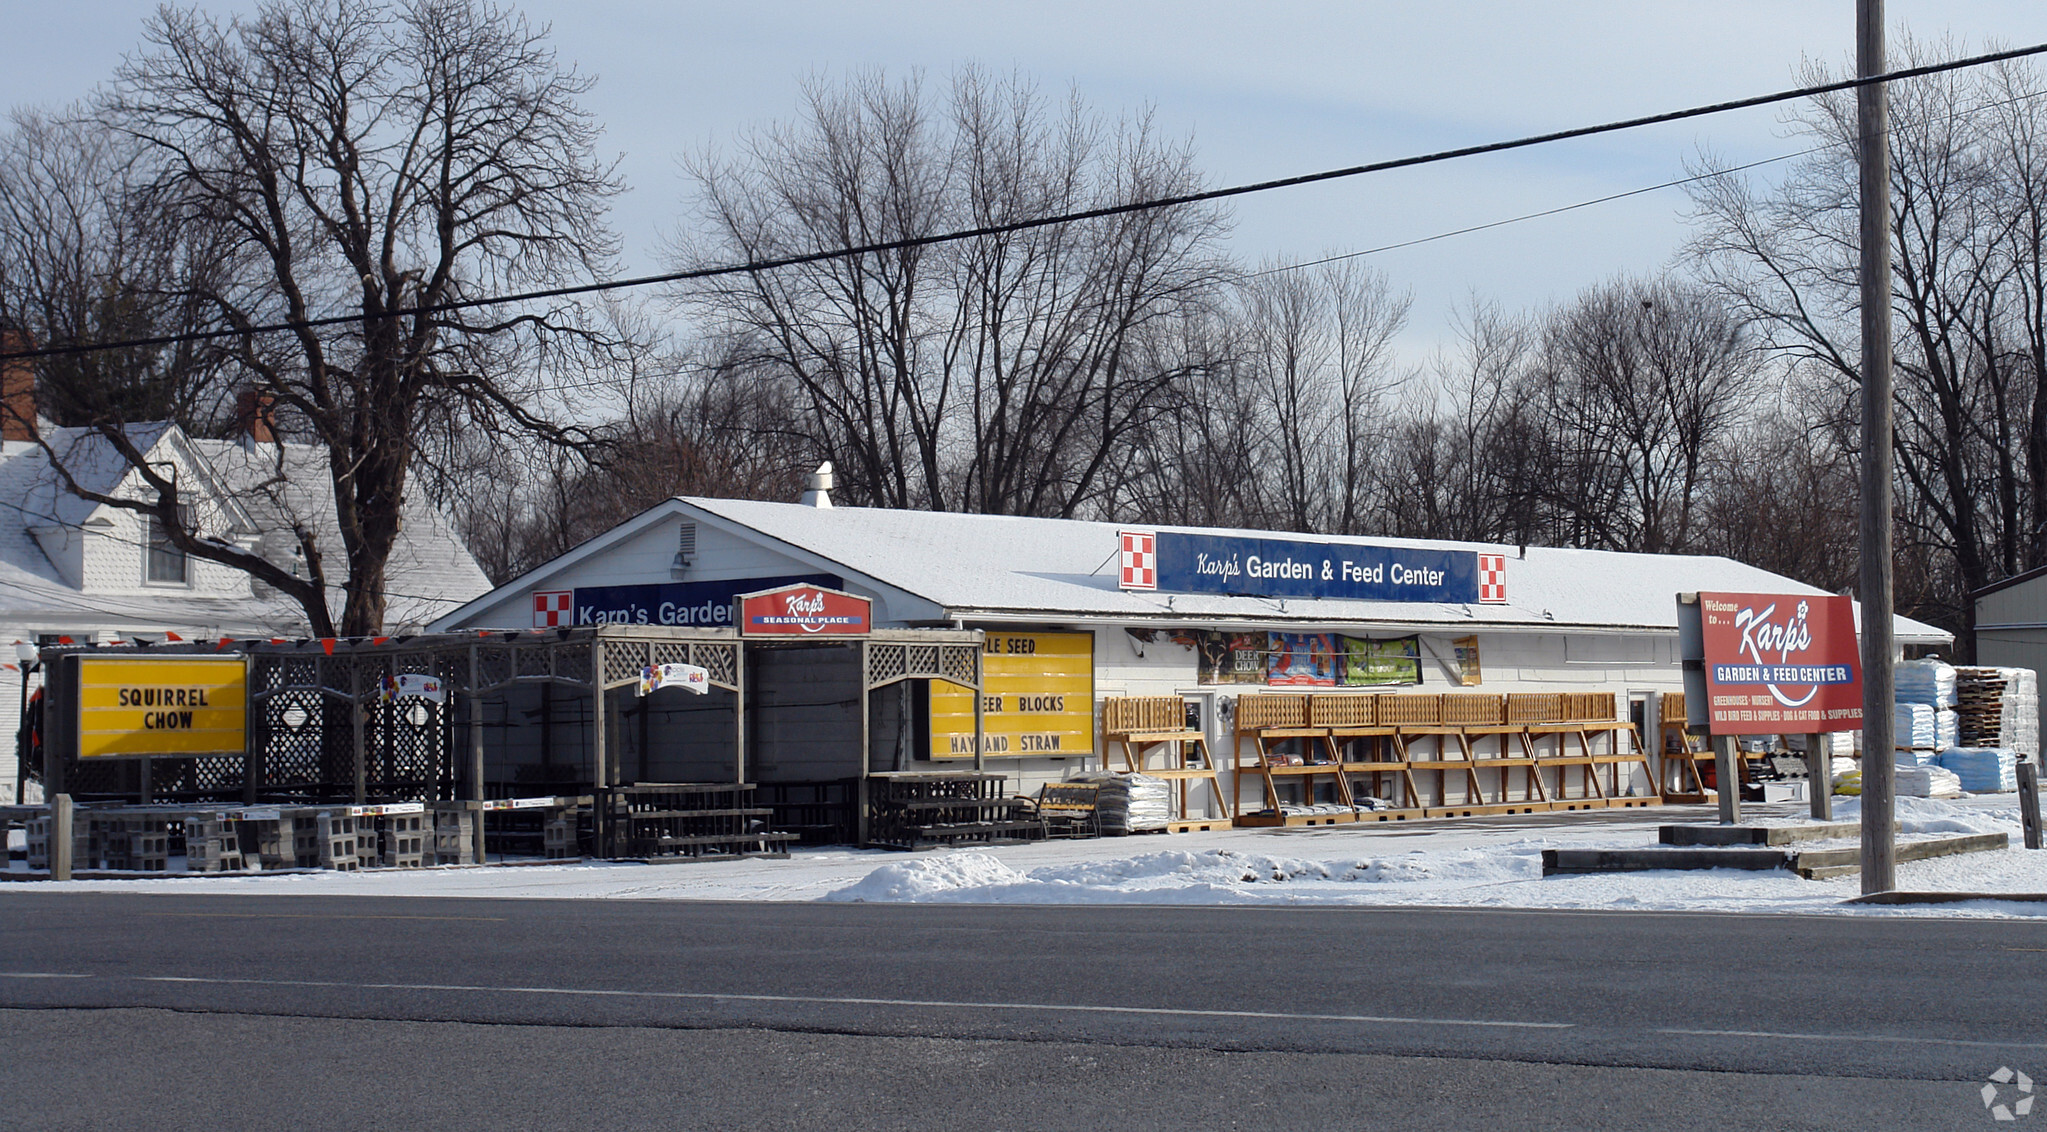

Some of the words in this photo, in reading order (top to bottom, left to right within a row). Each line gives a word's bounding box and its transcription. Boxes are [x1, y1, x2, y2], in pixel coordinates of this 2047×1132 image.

[1197, 552, 1240, 583] Karp's
[1246, 555, 1313, 579] Garden
[1321, 559, 1334, 580] &
[1342, 560, 1383, 583] Feed
[1390, 563, 1445, 586] Center
[785, 592, 825, 617] Karp's
[1705, 600, 1738, 612] Welcome
[763, 616, 816, 624] SEASONAL
[818, 616, 849, 624] PLACE
[1735, 600, 1811, 664] Karp's
[985, 638, 1001, 654] LE
[1007, 638, 1035, 654] SEED
[1234, 650, 1259, 660] DEER
[1234, 660, 1260, 672] CHOW
[1717, 667, 1760, 682] GARDEN
[1763, 667, 1770, 681] &
[1774, 667, 1798, 681] FEED
[1800, 666, 1847, 681] CENTER
[119, 688, 208, 706] SQUIRREL
[984, 697, 1003, 712] EER
[1019, 696, 1064, 712] BLOCKS
[144, 711, 193, 729] CHOW
[1714, 710, 1727, 721] WILD
[1728, 710, 1740, 721] BIRD
[1741, 710, 1752, 721] FEED
[1758, 710, 1780, 721] SUPPLIES
[1799, 710, 1808, 721] CAT
[1808, 710, 1820, 721] FOOD
[1821, 709, 1827, 720] &
[1828, 708, 1863, 720] SUPPLIES
[951, 736, 975, 753] HAY
[985, 736, 1008, 752] AND
[1020, 735, 1060, 751] STRAW
